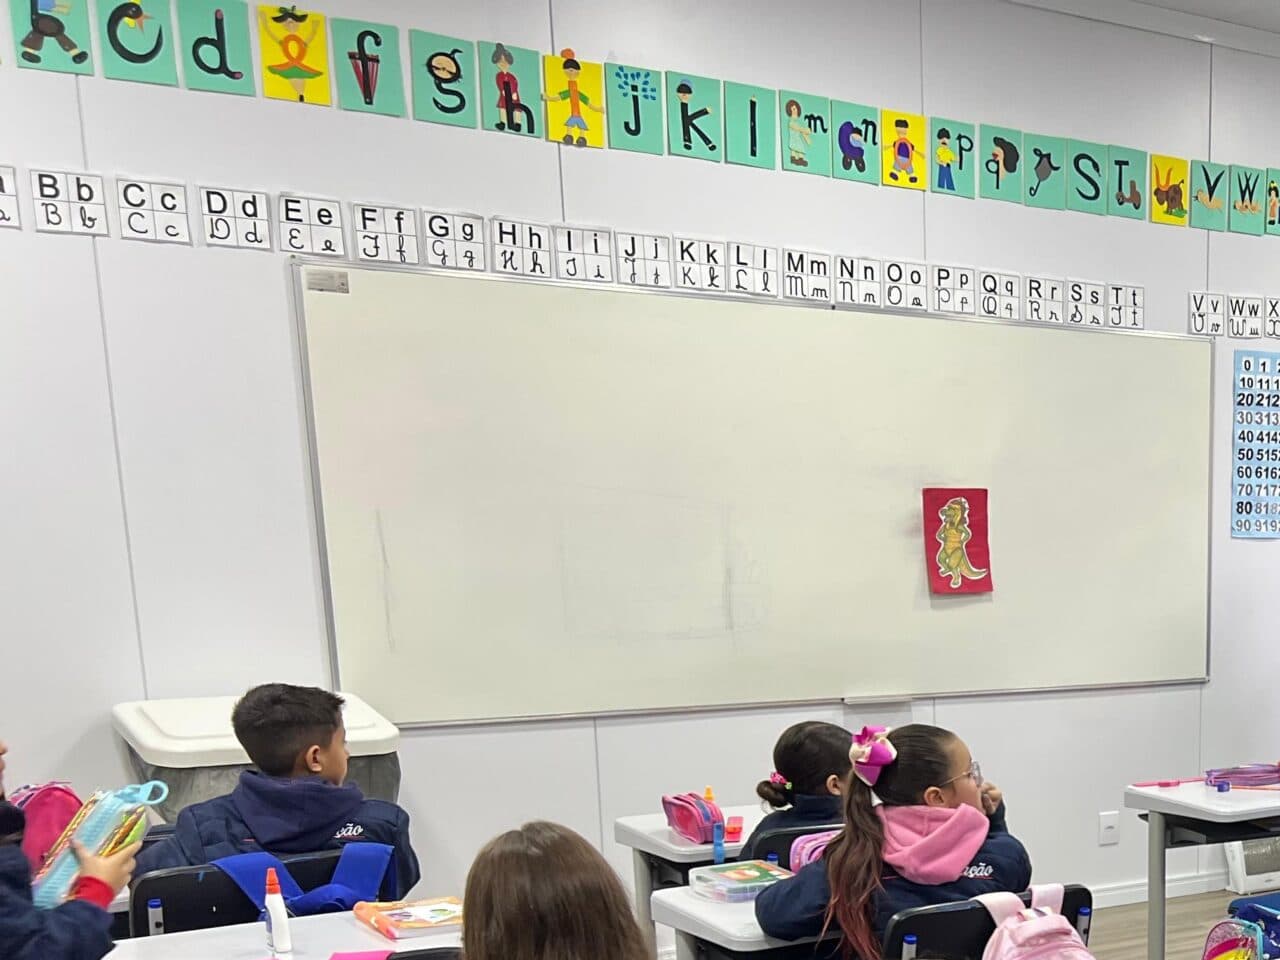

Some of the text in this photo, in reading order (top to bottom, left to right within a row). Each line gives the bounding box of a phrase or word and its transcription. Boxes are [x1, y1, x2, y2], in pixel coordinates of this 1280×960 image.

[1244, 360, 1251, 371] 0
[1261, 361, 1266, 373] 1
[1240, 377, 1253, 388] 10
[1258, 378, 1269, 390] 11
[1237, 393, 1254, 406] 20
[1256, 393, 1270, 407] 21
[1237, 411, 1253, 424] 30
[1255, 412, 1270, 425] 31
[1239, 430, 1253, 443] 40
[1257, 431, 1270, 443] 41
[1238, 449, 1253, 460] 50
[1256, 449, 1269, 460] 51
[1237, 466, 1252, 478] 60
[1255, 467, 1269, 478] 61
[1238, 484, 1252, 496] 70
[1256, 484, 1269, 496] 71
